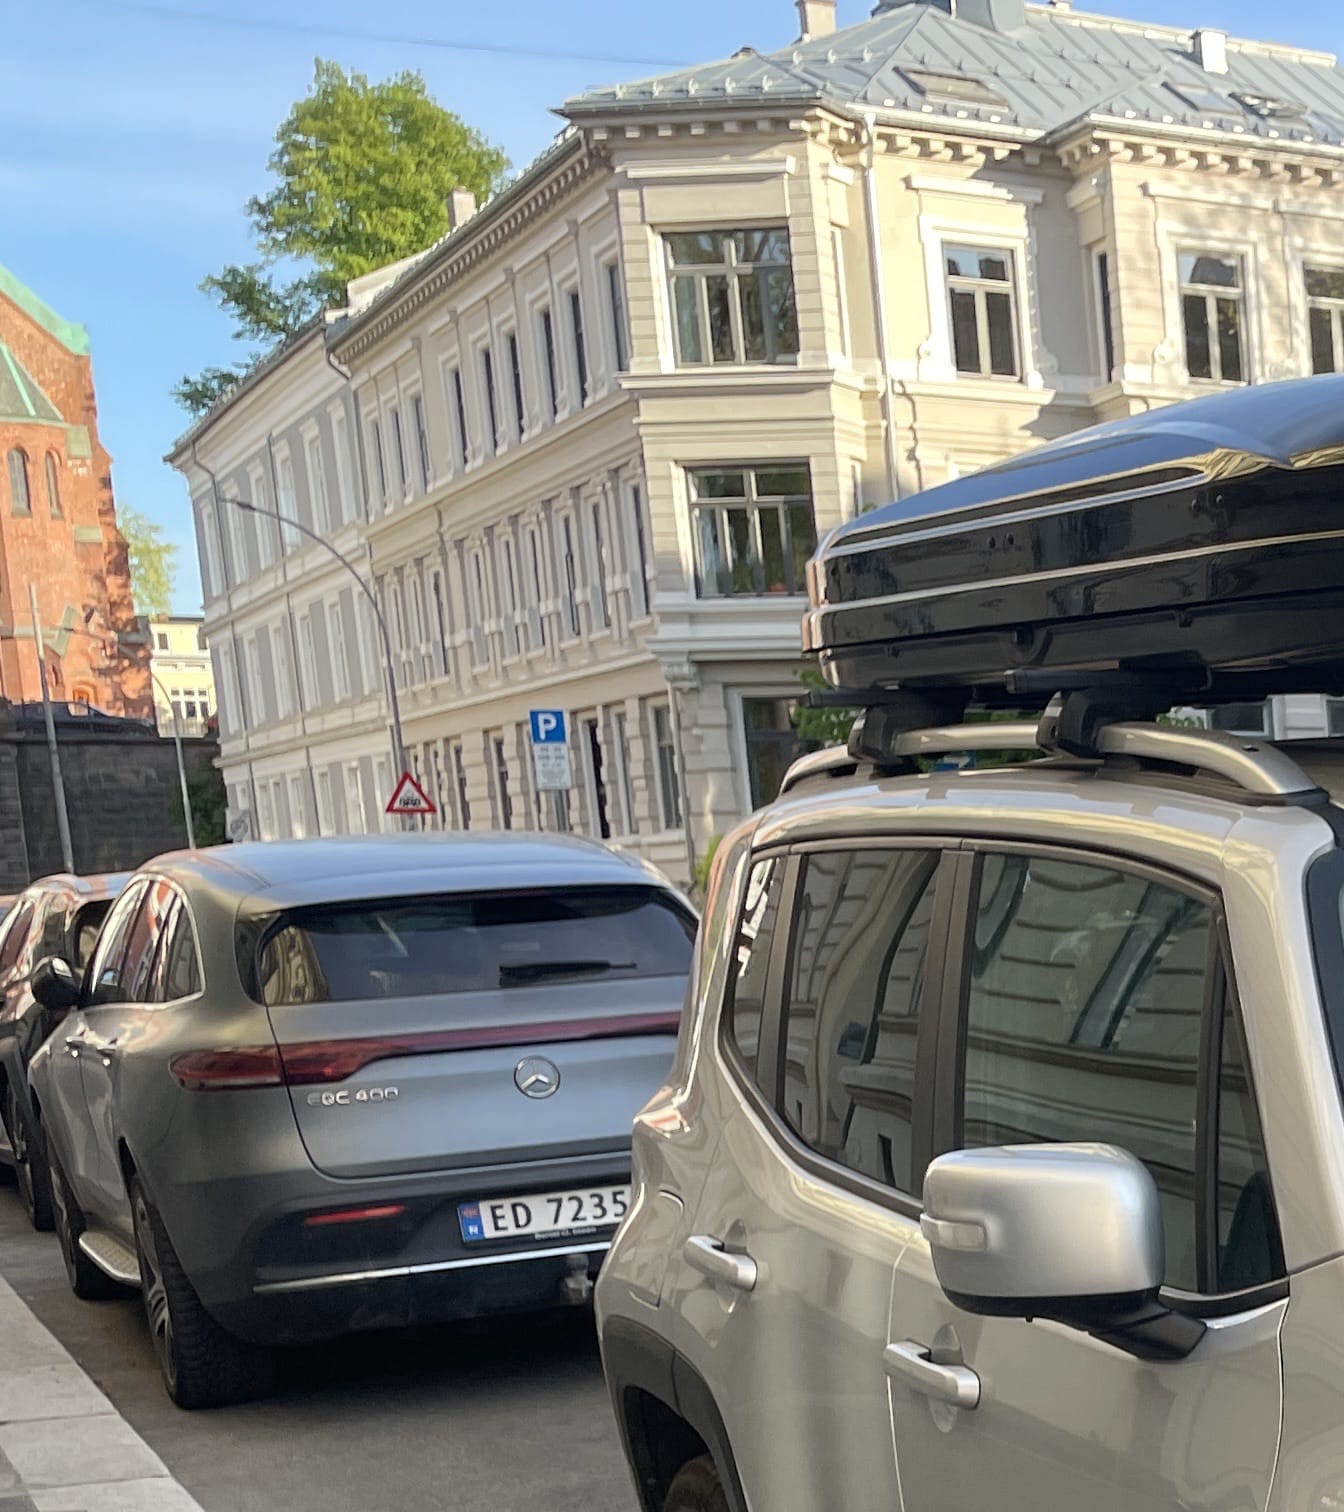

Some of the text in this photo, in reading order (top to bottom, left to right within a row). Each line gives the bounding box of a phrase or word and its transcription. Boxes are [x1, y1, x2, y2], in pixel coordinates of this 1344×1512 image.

[537, 713, 557, 740] P
[307, 1086, 399, 1106] EQC 400
[490, 1190, 628, 1232] ED 7235
